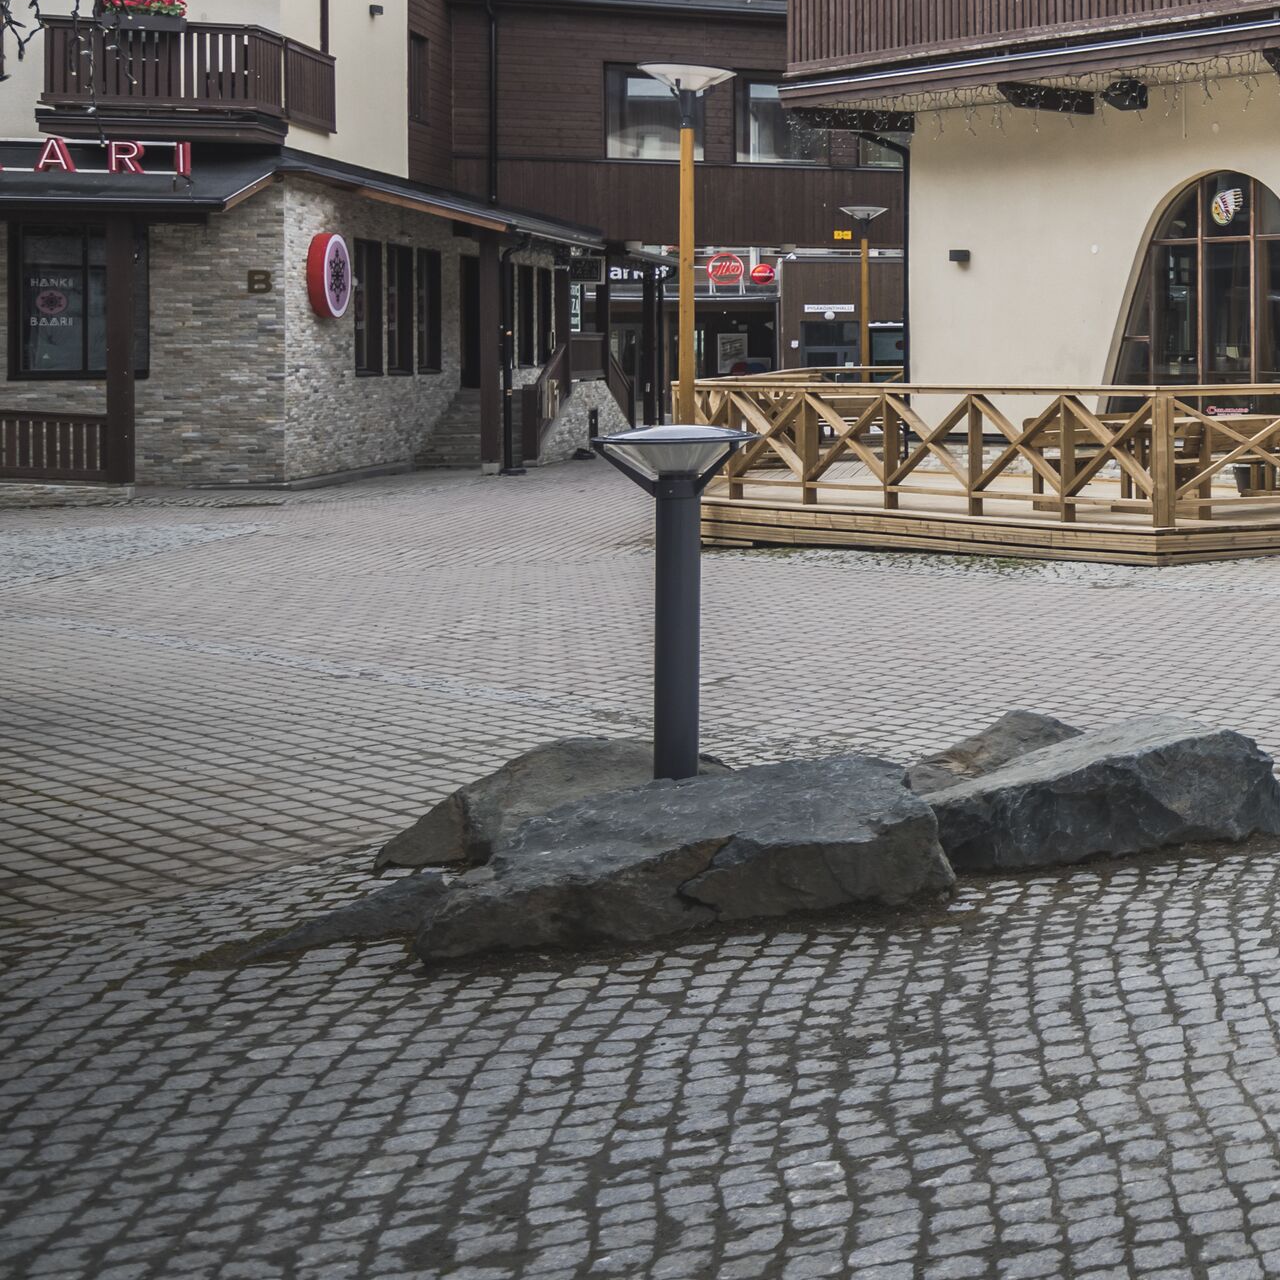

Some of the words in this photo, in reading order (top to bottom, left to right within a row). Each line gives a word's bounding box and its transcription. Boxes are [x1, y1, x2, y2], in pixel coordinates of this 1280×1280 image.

[0, 136, 192, 176] ARI
[30, 278, 74, 288] HANKI
[247, 269, 273, 294] B
[30, 317, 73, 326] BAARI
